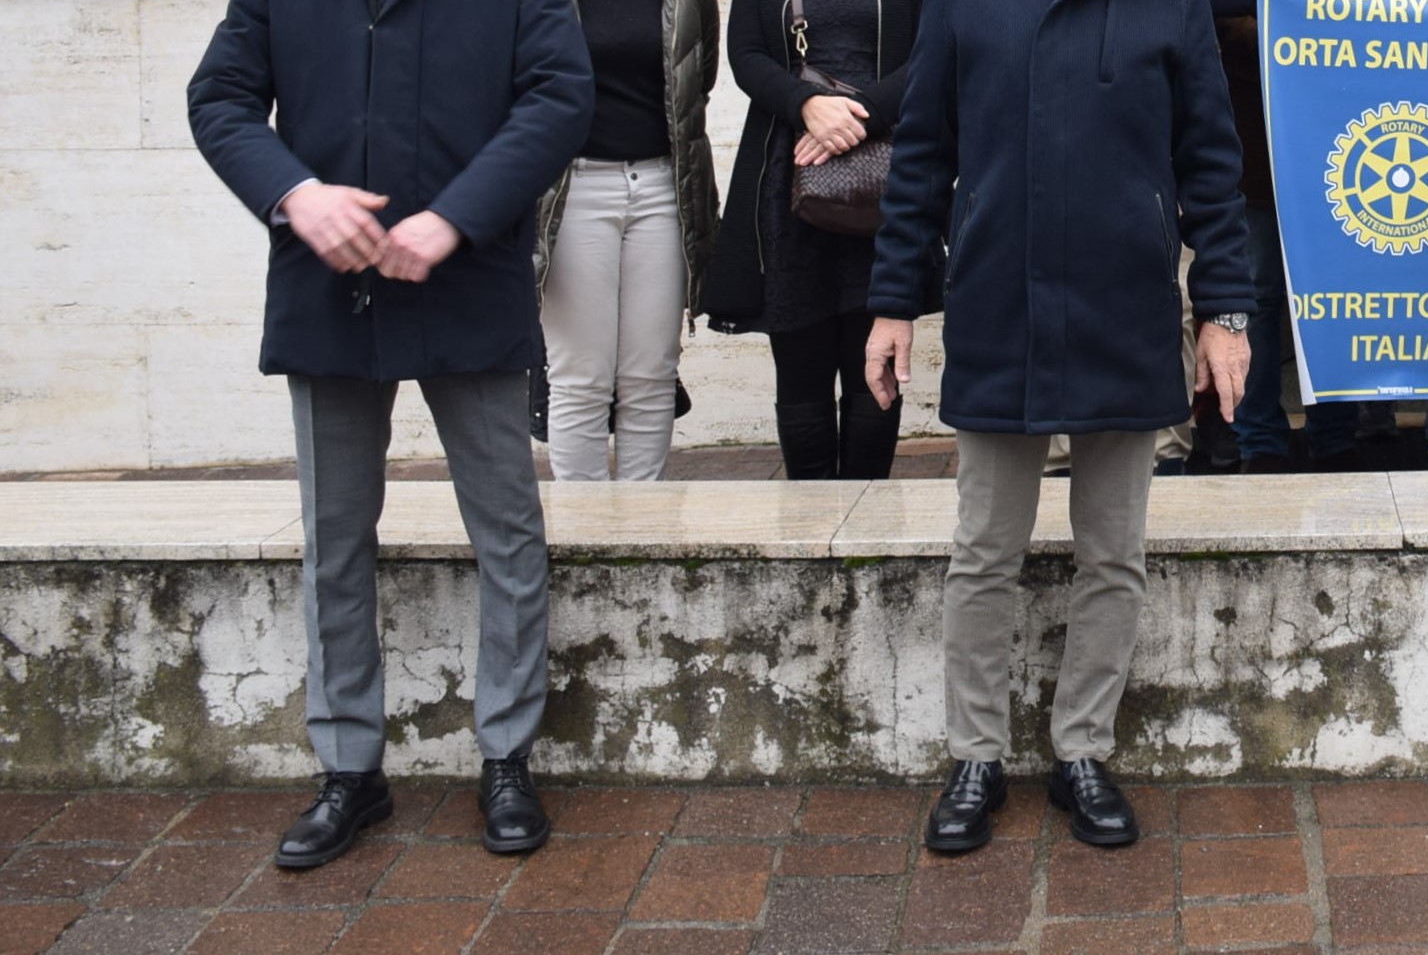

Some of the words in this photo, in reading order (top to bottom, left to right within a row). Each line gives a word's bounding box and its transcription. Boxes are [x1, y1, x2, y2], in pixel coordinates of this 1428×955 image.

[1274, 37, 1357, 67] ORTA
[1365, 40, 1428, 70] SAN
[1380, 121, 1426, 135] ROTARY
